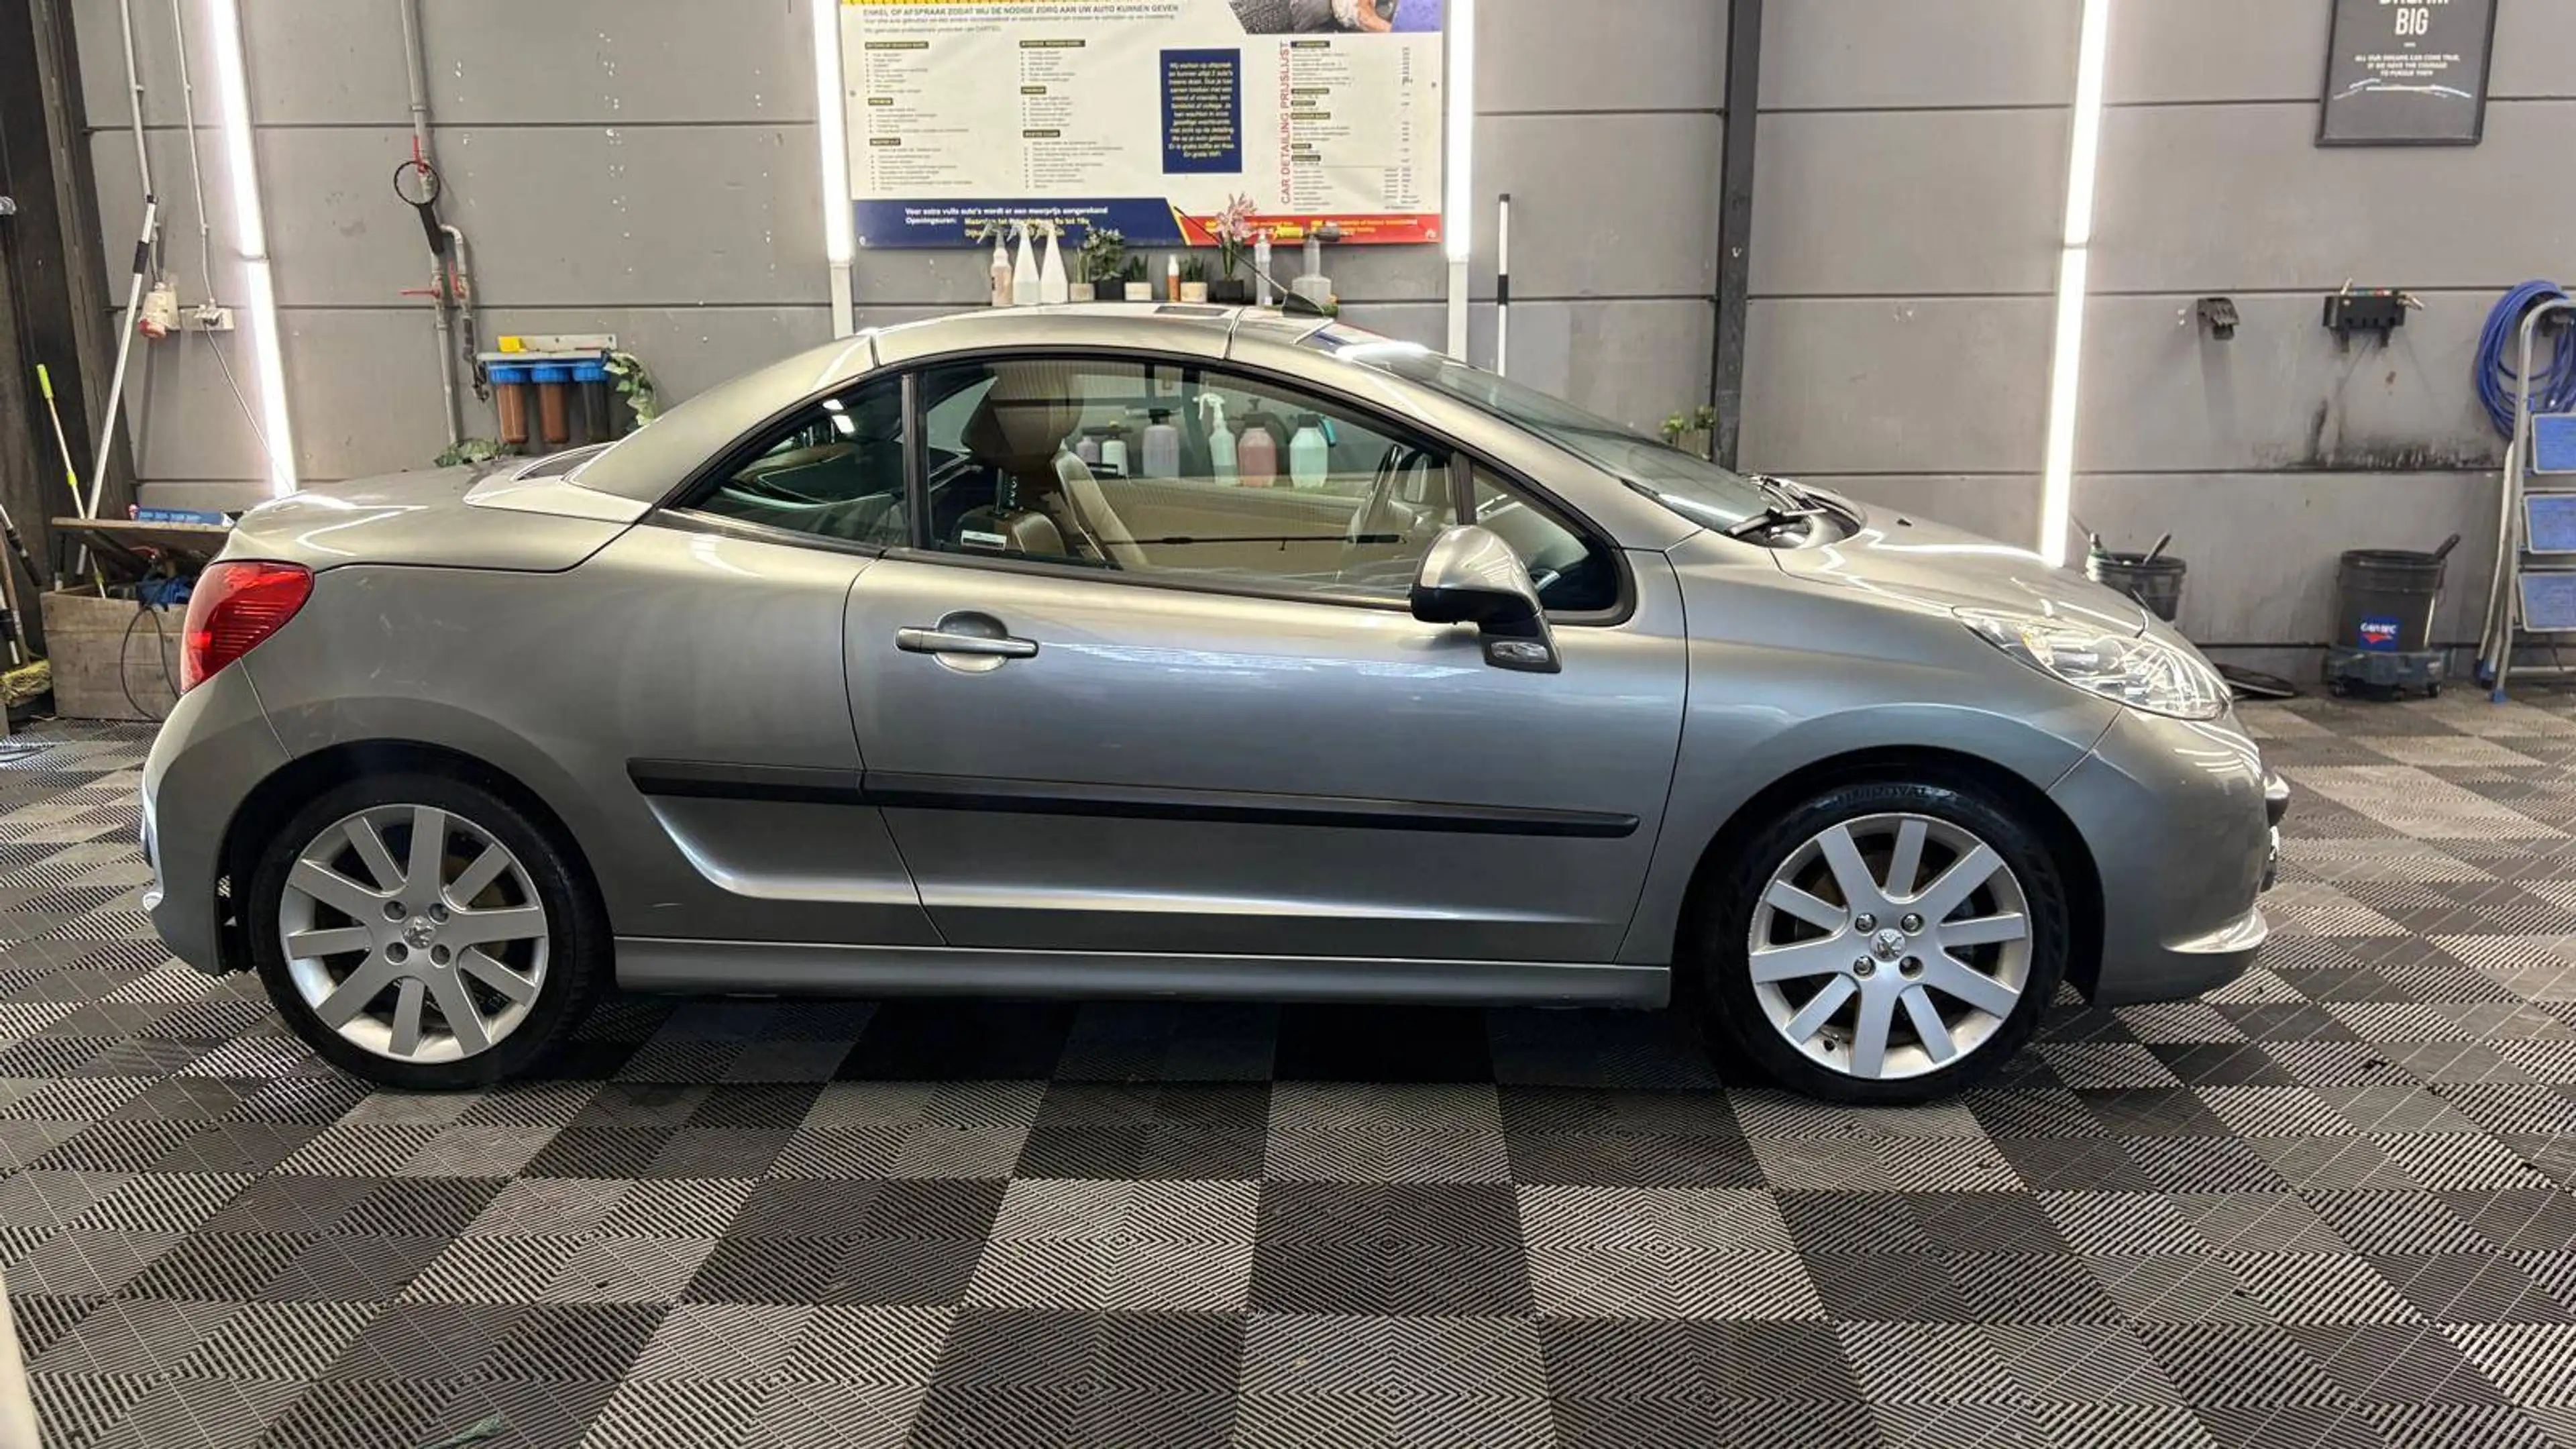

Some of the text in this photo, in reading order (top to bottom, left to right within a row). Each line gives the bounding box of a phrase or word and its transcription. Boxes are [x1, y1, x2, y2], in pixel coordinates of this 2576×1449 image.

[2396, 8, 2428, 35] BIG
[1280, 113, 1290, 175] DETAILING
[1281, 180, 1291, 204] CAR
